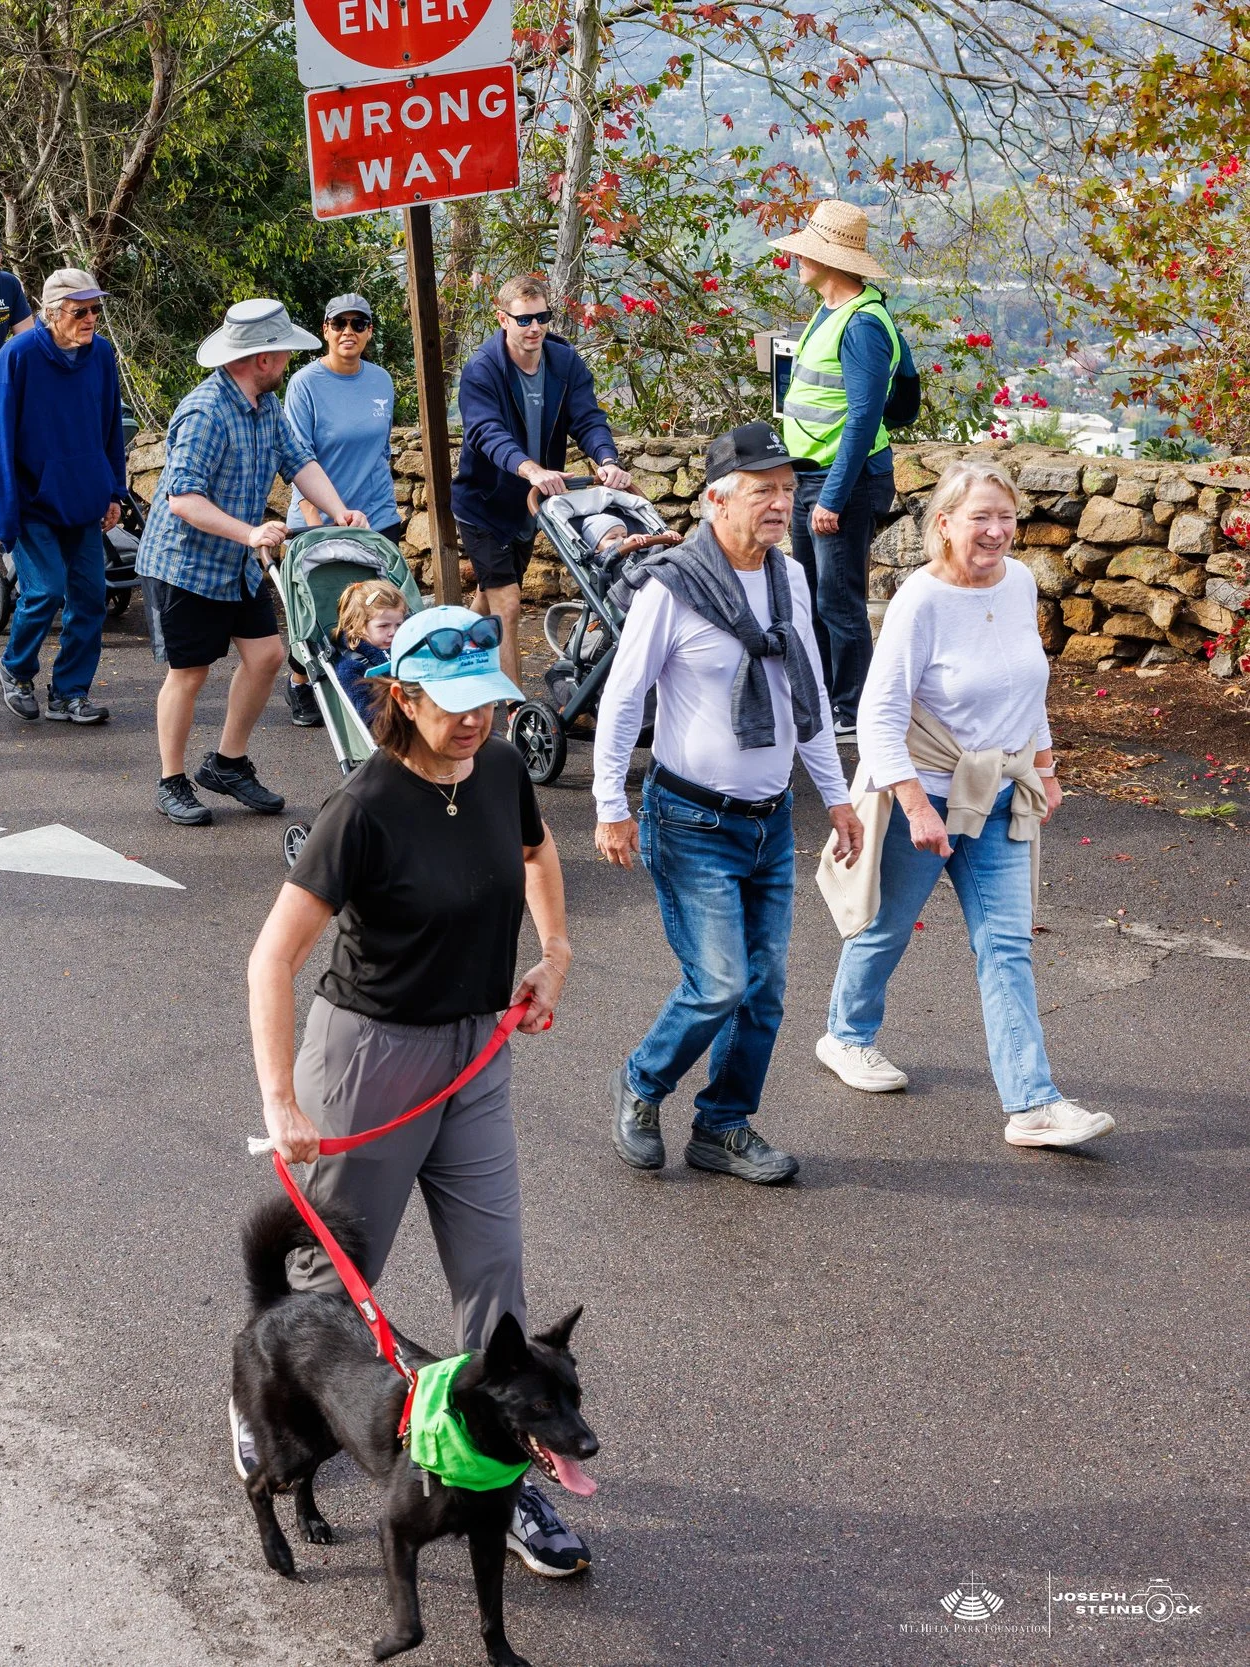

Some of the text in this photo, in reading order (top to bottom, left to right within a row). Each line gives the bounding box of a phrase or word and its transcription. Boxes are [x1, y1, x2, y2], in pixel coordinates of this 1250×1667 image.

[338, 0, 469, 35] ENTER
[317, 84, 507, 143] WRONG
[357, 144, 473, 194] WAY
